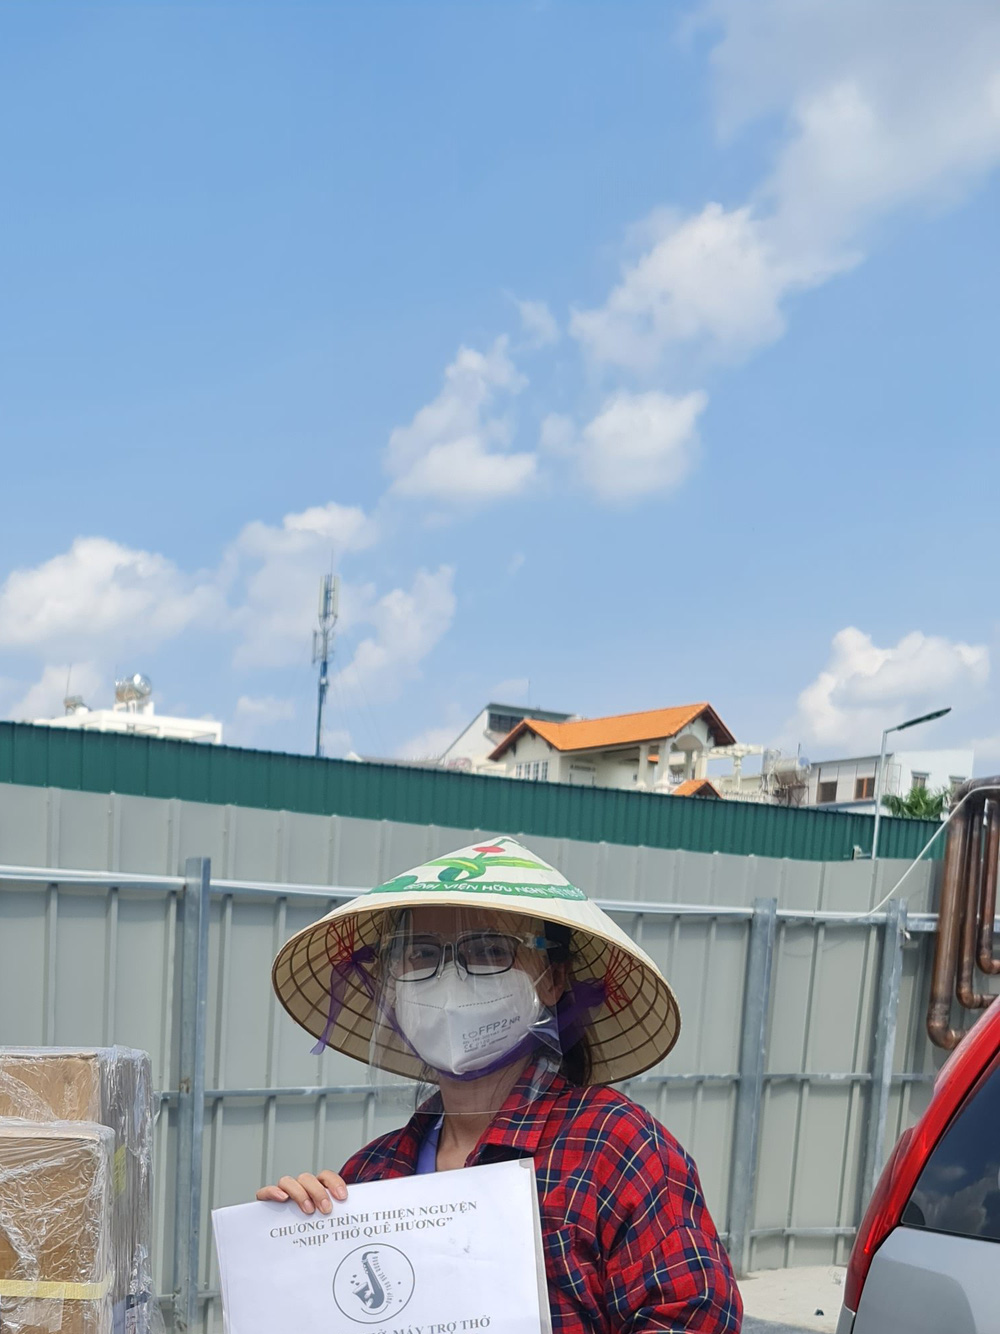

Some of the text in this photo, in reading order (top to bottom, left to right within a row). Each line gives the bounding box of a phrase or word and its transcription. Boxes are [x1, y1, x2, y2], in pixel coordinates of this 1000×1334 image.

[479, 1018, 508, 1036] FFP2
[269, 1201, 477, 1238] CHƯƠNG TRÌNH THIỆN NGUYỆN
[332, 1226, 361, 1241] THỞ
[363, 1221, 391, 1238] QUÊ
[427, 1321, 457, 1334] TRỢ
[459, 1314, 491, 1330] THỞ
